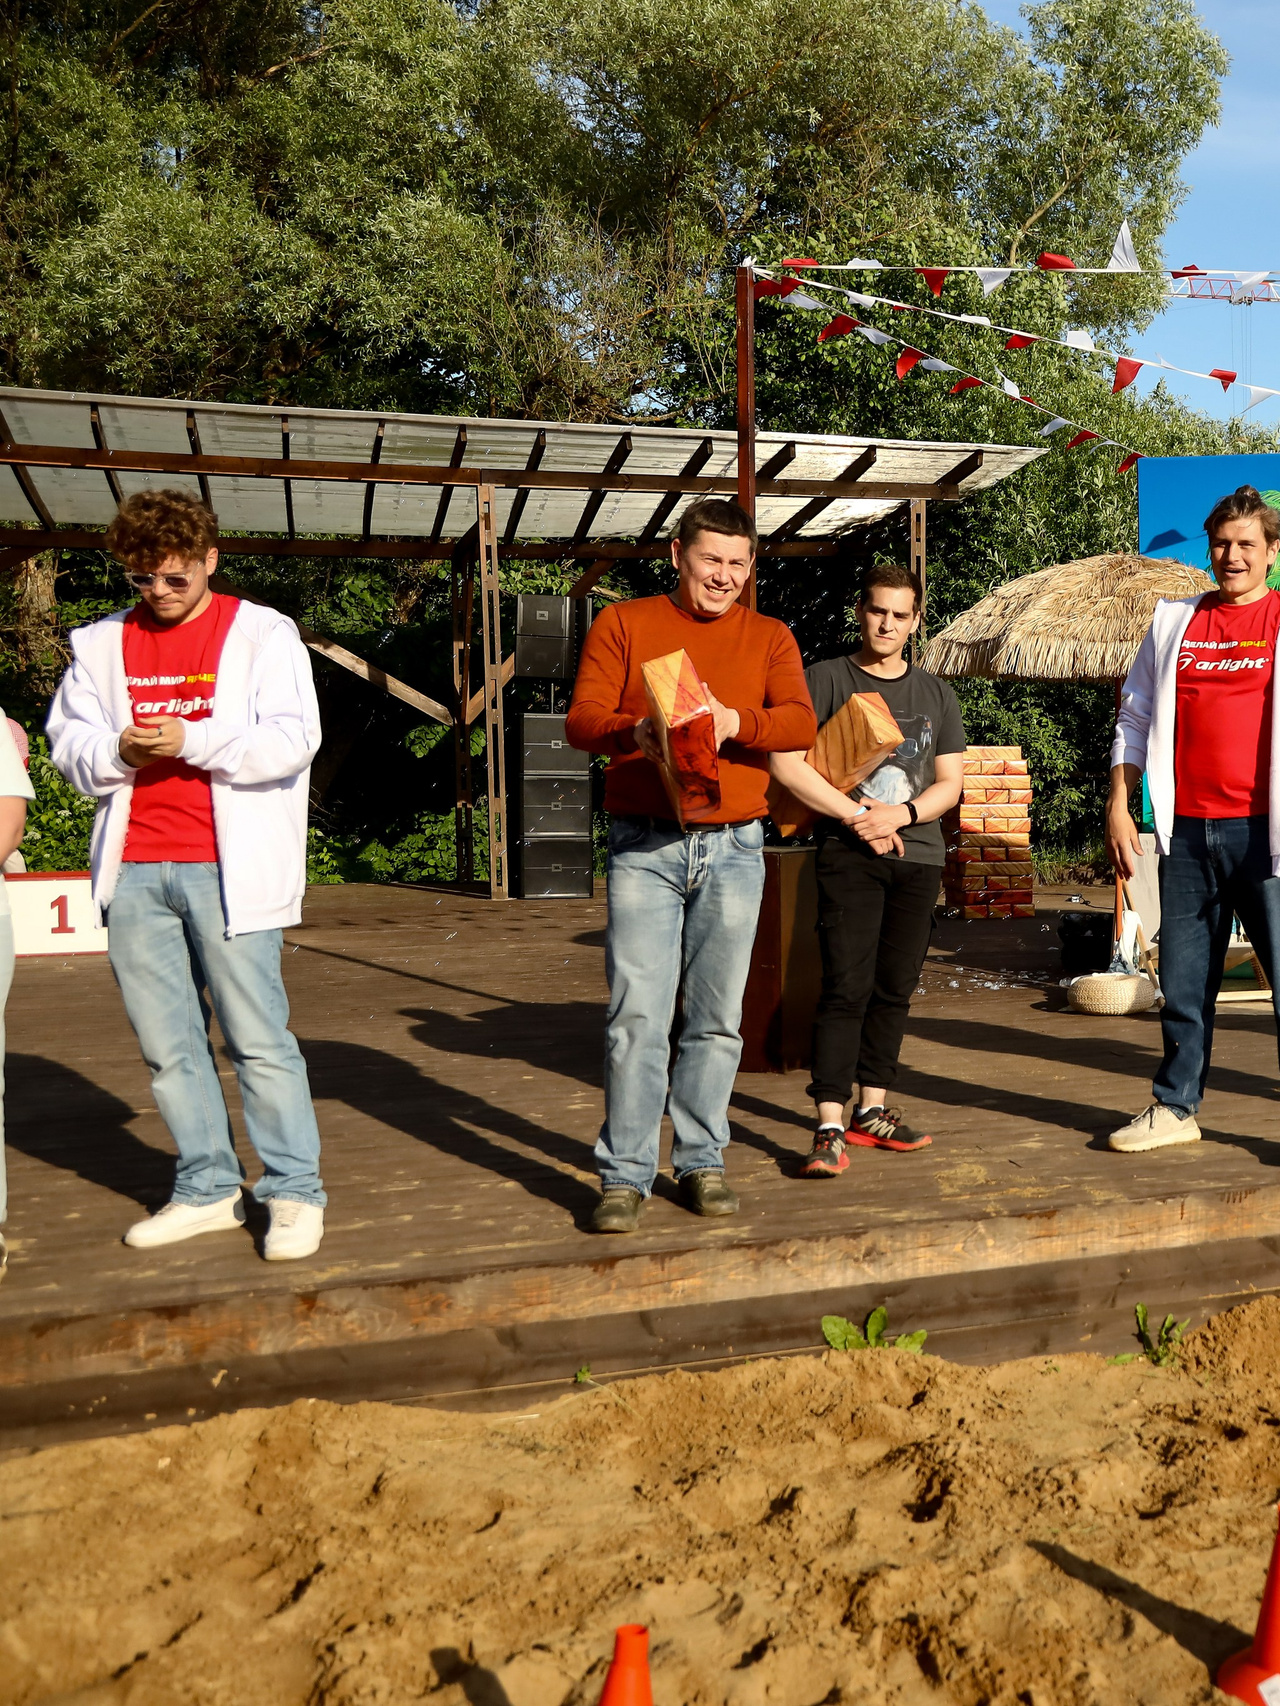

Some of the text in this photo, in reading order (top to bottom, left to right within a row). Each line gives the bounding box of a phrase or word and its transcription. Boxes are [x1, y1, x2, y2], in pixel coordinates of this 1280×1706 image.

[1182, 640, 1267, 650] ДЕЛАЙ МИР ЯРЧЕ
[1195, 657, 1266, 673] arlight
[125, 675, 158, 687] ЕЛАЙ
[160, 675, 186, 686] МИР
[51, 895, 76, 934] 1
